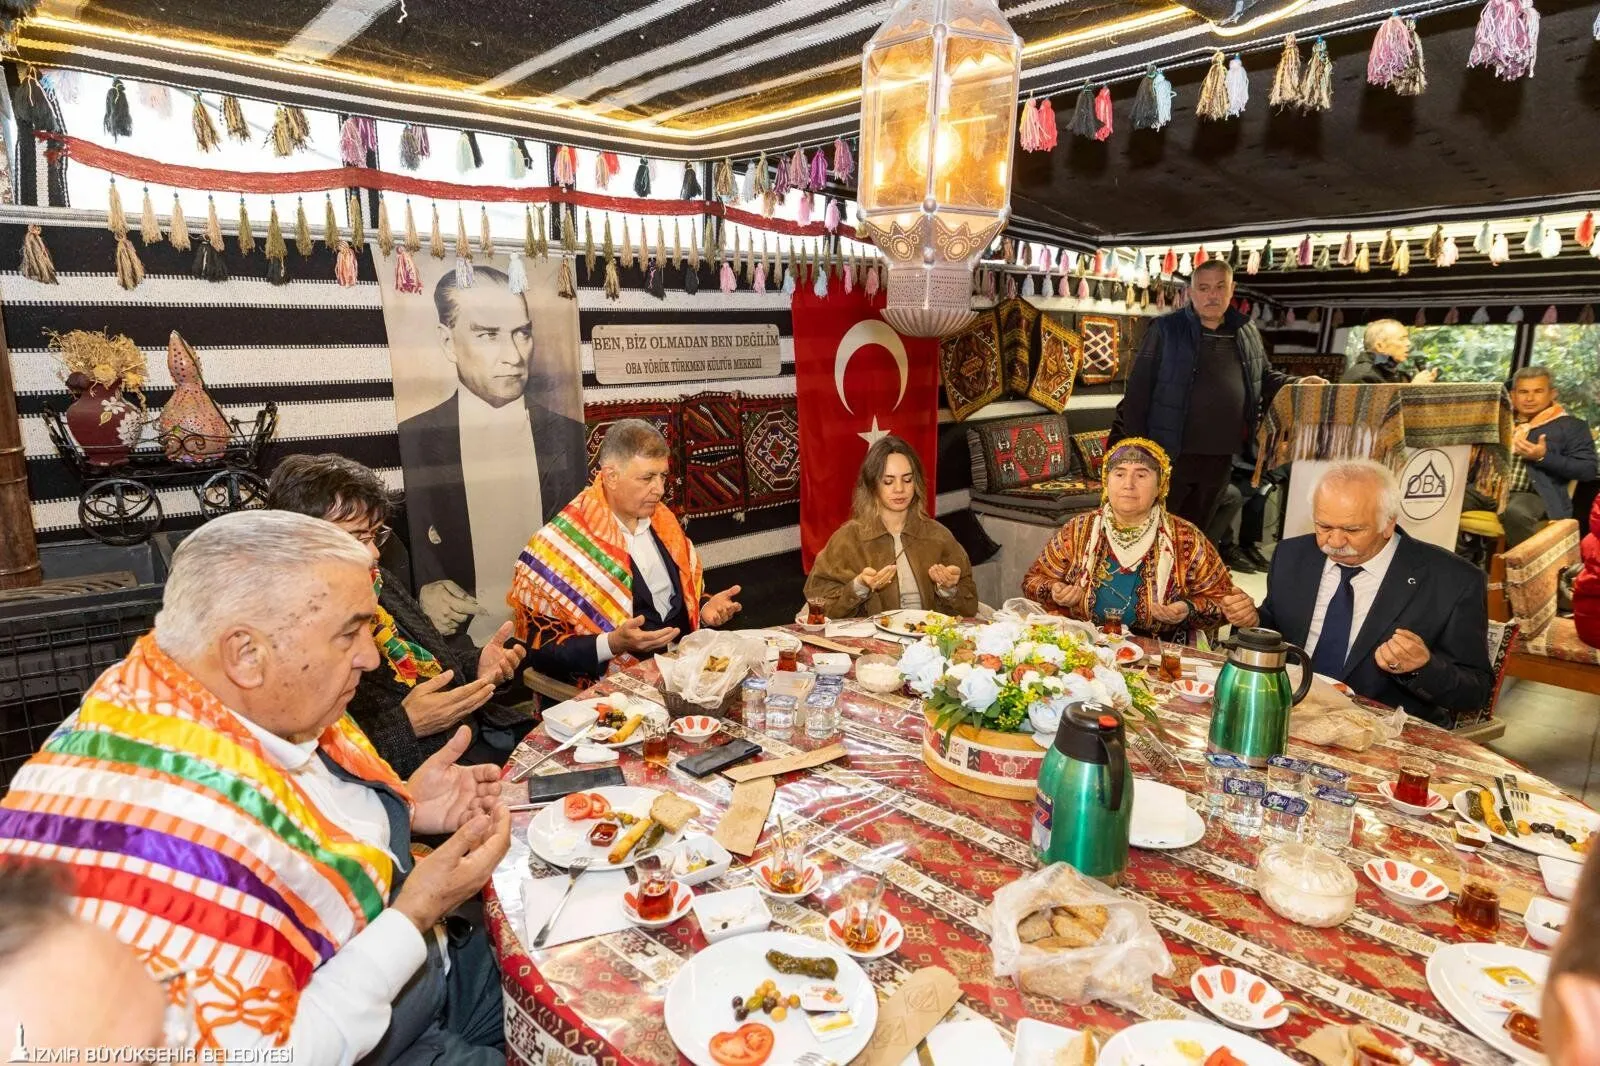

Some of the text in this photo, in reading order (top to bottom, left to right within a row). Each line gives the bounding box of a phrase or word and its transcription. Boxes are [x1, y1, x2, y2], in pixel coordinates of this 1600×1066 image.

[593, 331, 779, 352] BEN, BİZ OLMADAN BEN DEĞİLİM
[625, 356, 762, 375] OBA YÖRÜK TÜRKMEN KÜLTÜR MERKEZİ
[1407, 474, 1447, 495] OBA
